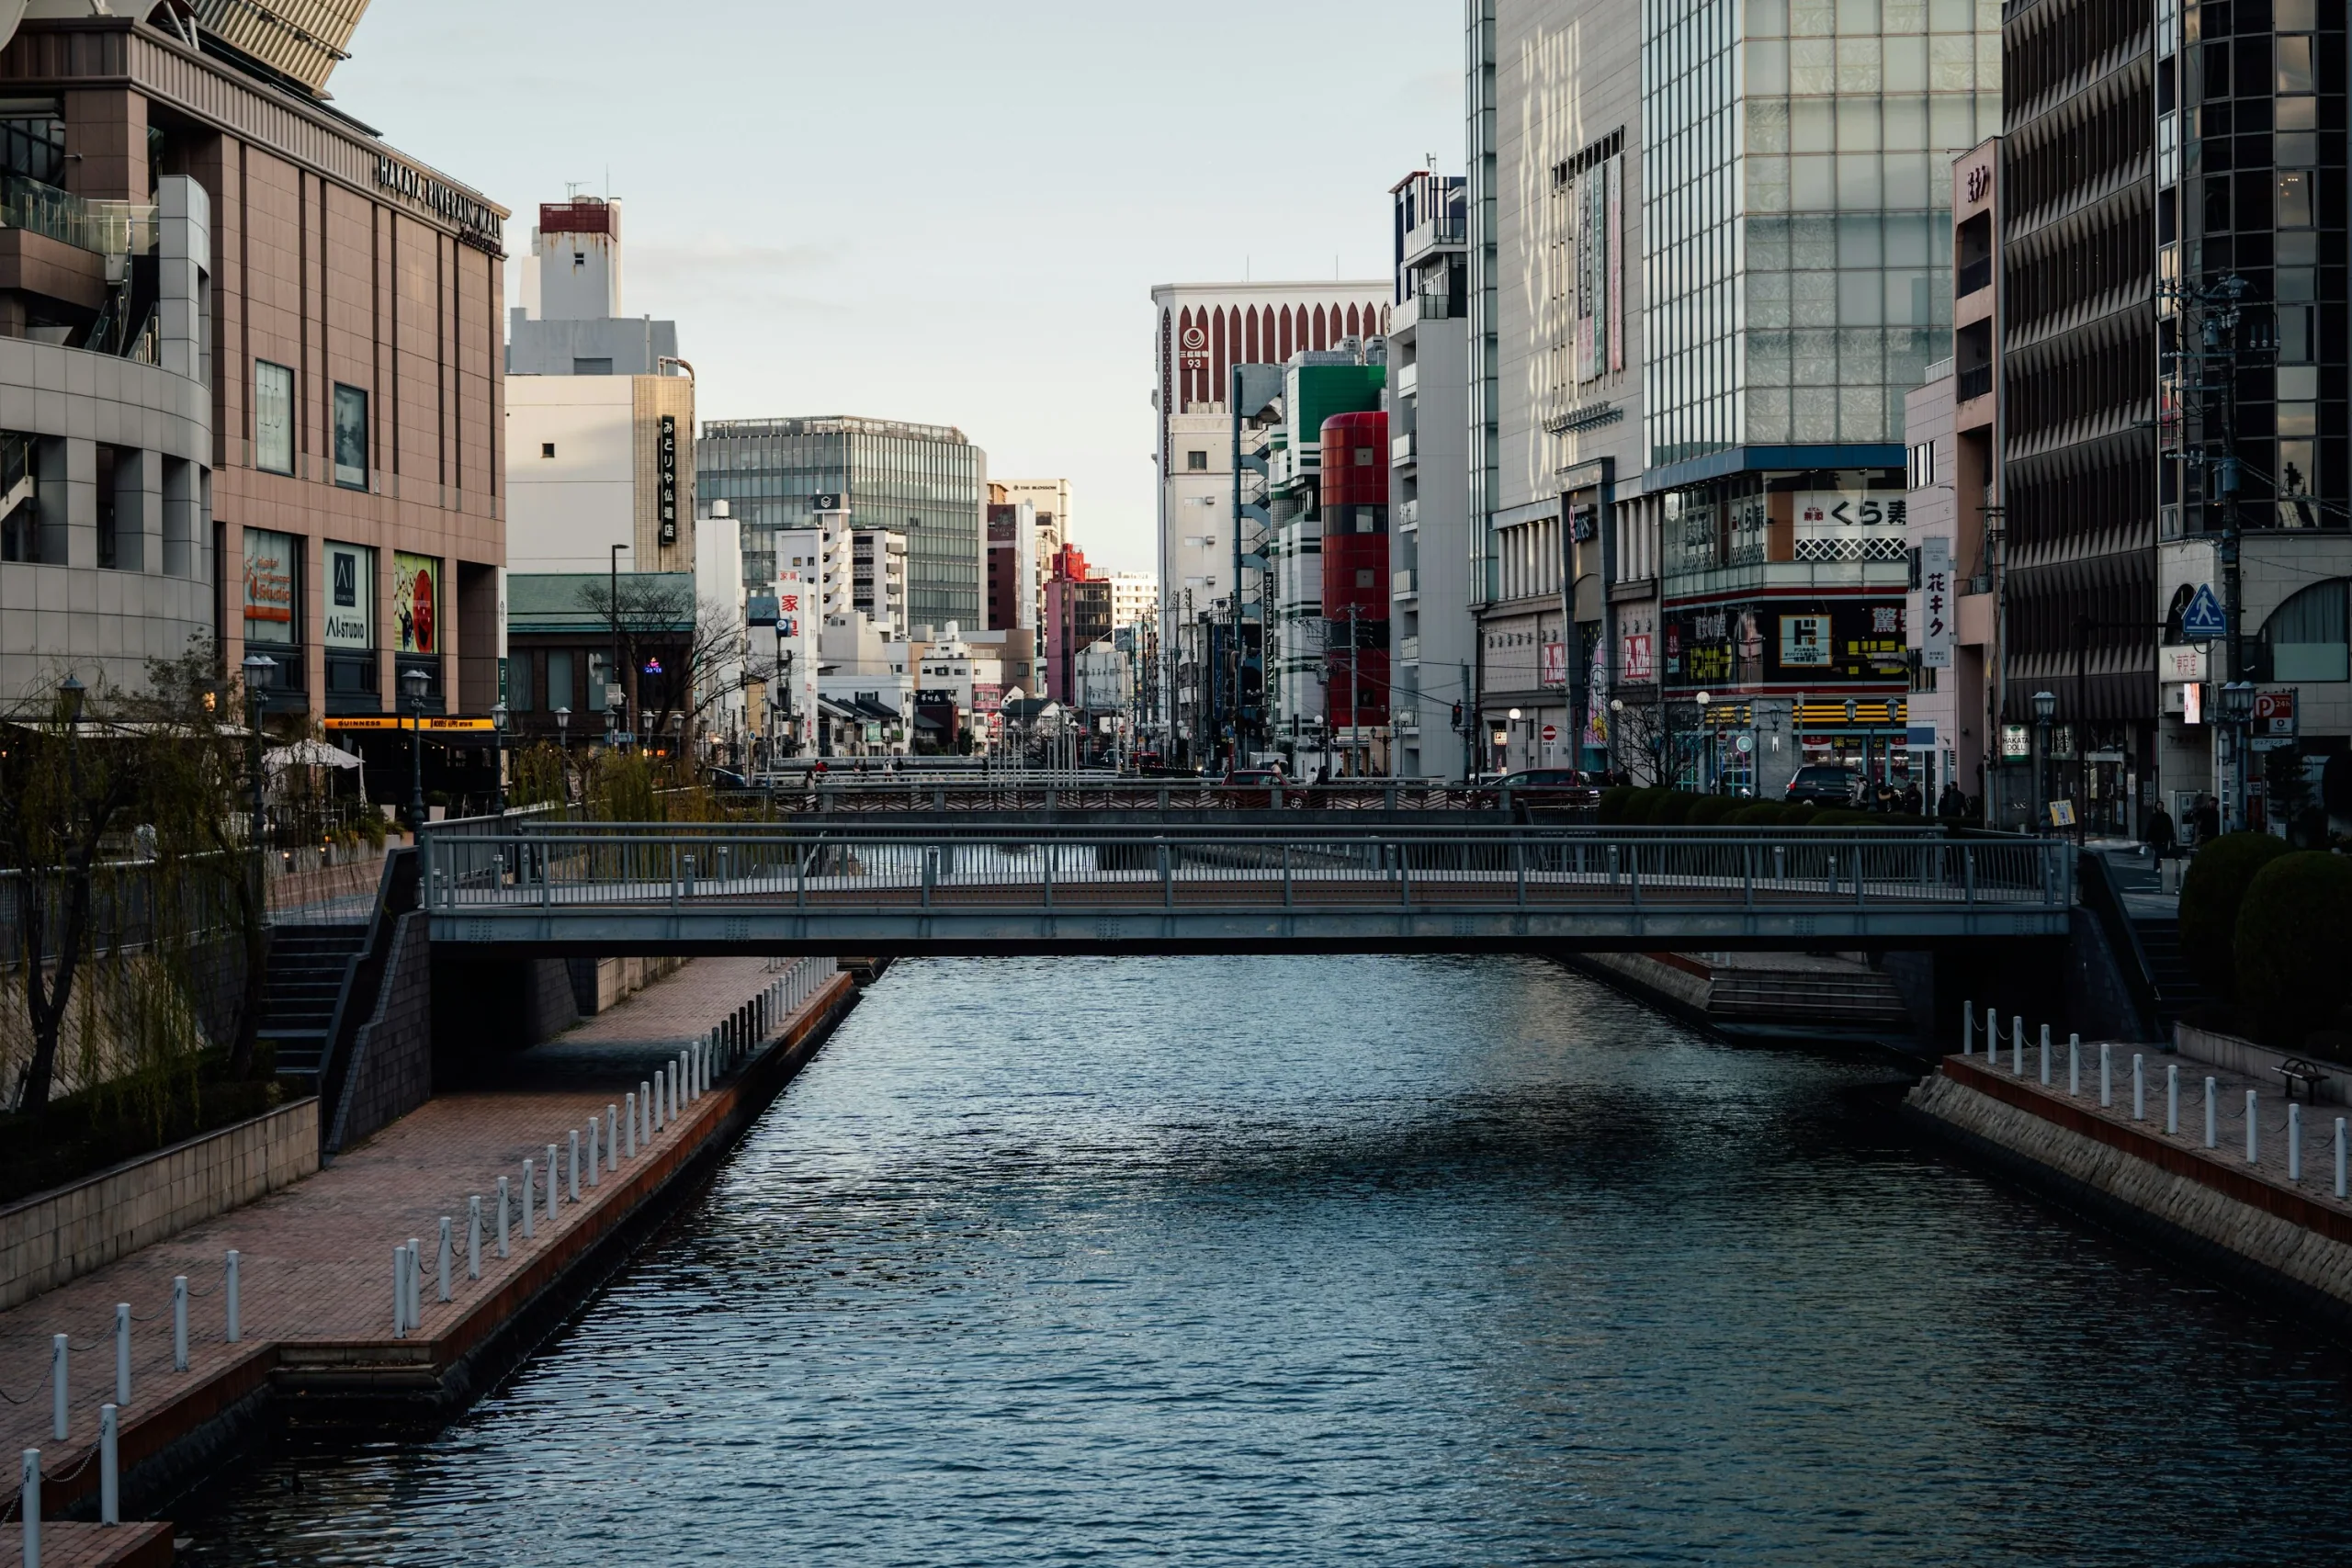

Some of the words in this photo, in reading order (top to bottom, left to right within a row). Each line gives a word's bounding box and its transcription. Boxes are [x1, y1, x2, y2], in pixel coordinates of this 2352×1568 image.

[379, 155, 425, 201] HAKATA
[426, 179, 475, 228] RIVERAIN
[478, 204, 503, 240] MALL
[1188, 359, 1201, 368] 93
[663, 422, 673, 537] みどりや仏壇店
[1927, 572, 1945, 637] 花キク
[2256, 695, 2275, 717] P
